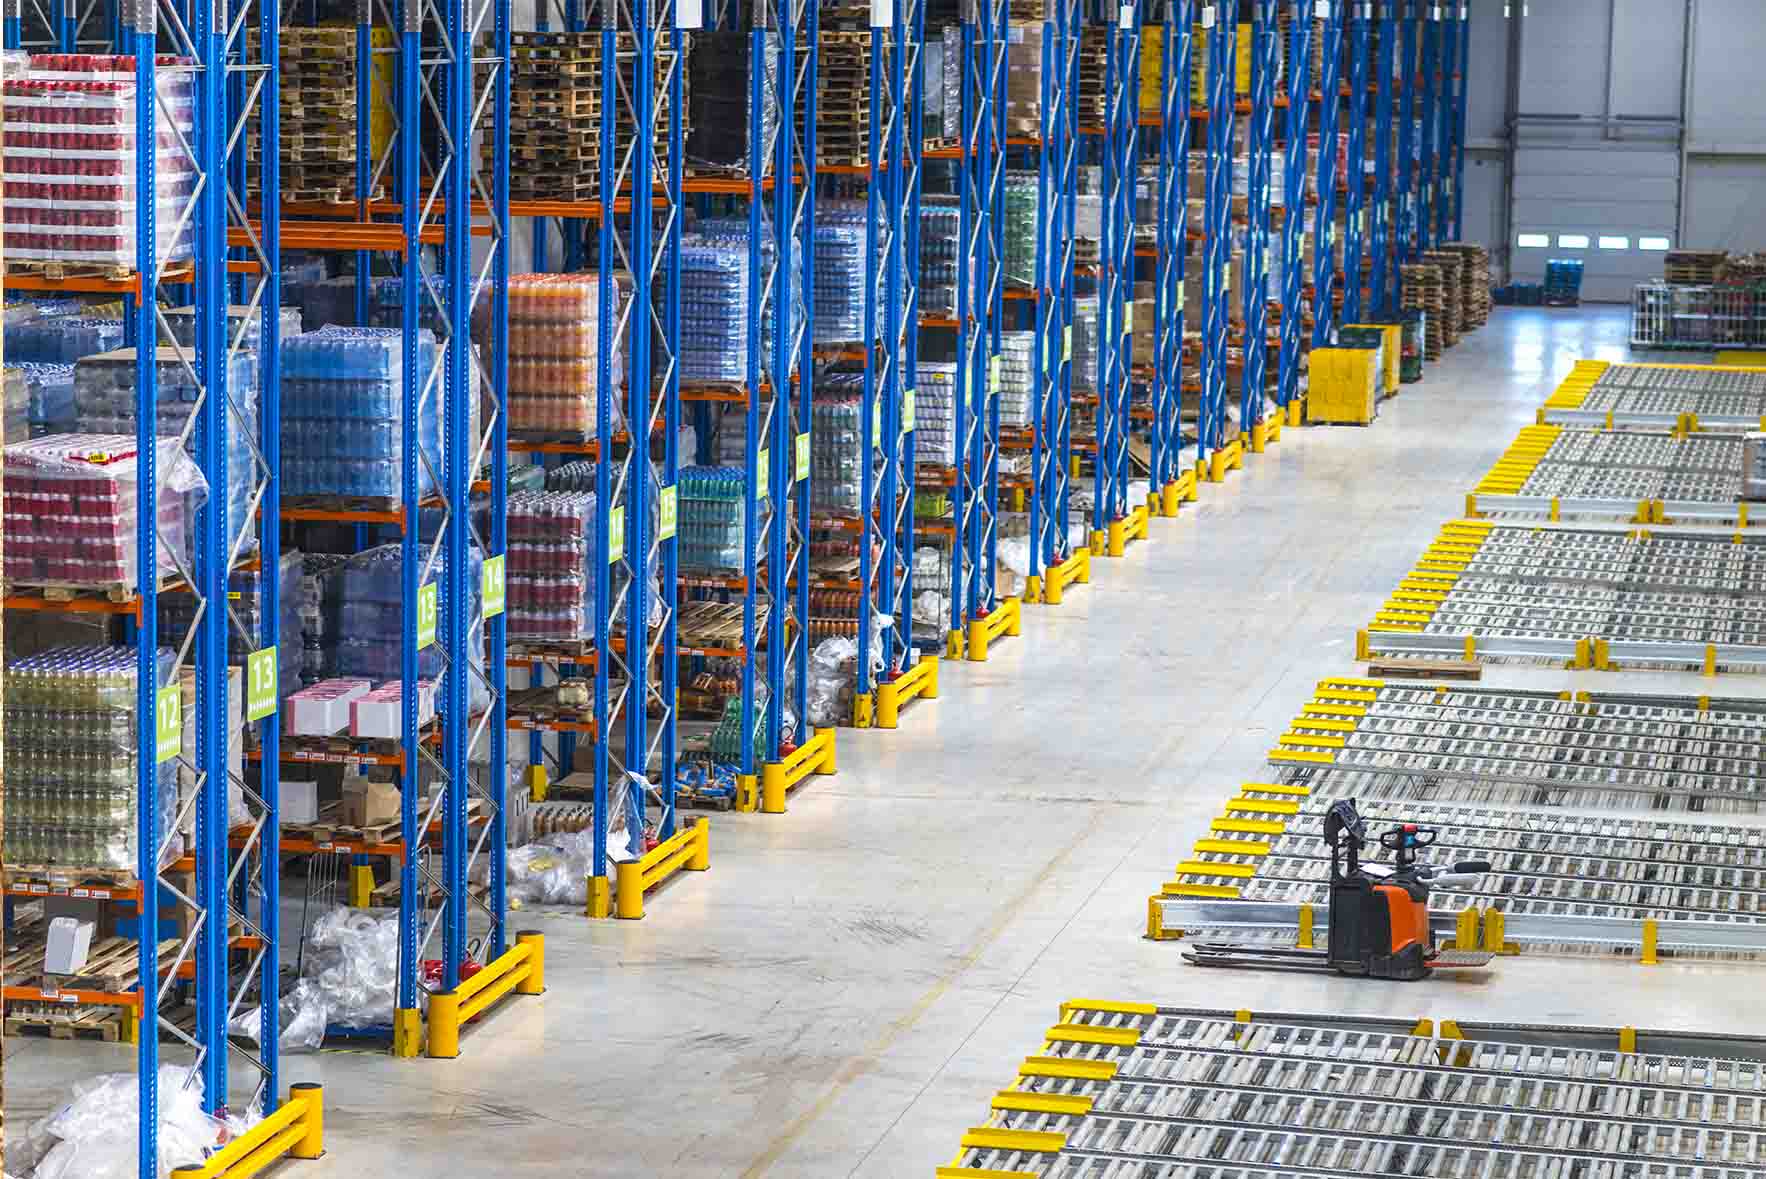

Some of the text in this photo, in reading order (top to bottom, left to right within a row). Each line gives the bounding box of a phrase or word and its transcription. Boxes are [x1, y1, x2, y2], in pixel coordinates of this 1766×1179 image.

[488, 561, 502, 592] 14
[421, 591, 434, 624] 13
[254, 655, 273, 693] 13
[160, 693, 178, 733] 12
